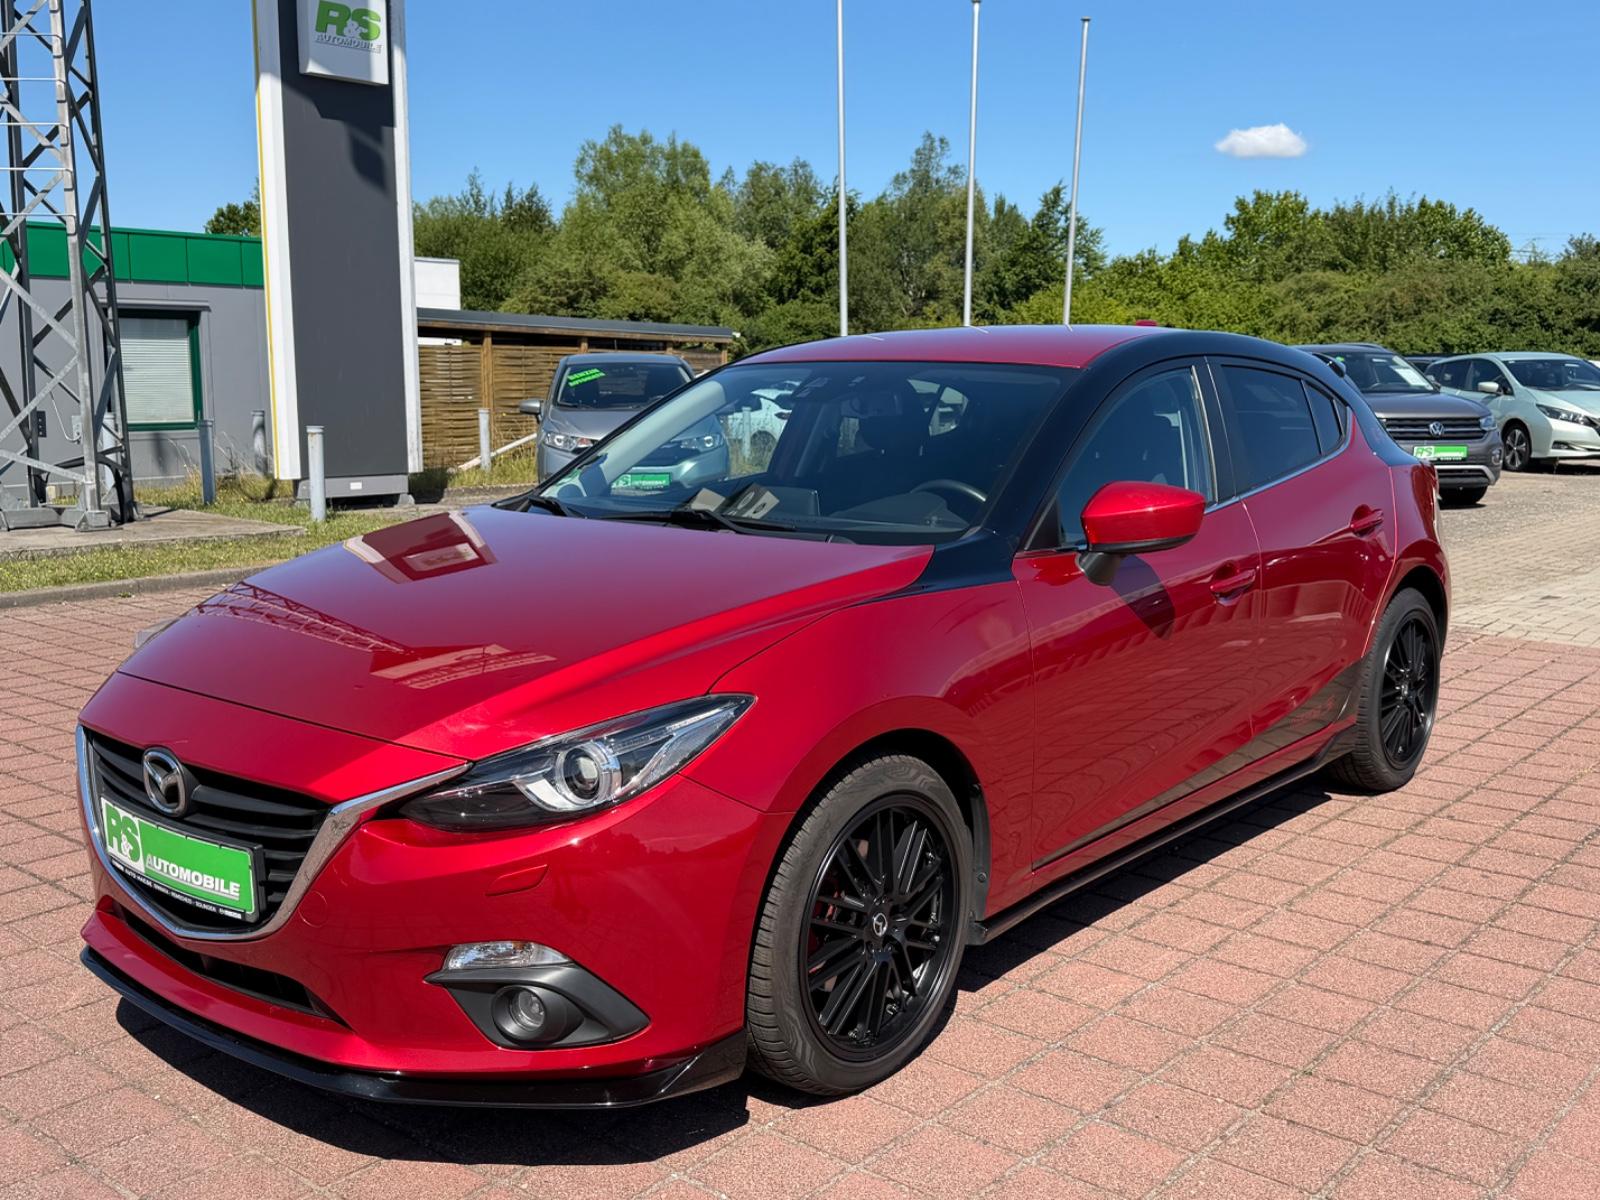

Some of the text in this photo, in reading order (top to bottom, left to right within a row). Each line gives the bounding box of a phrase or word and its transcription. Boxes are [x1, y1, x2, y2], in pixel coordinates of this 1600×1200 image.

[315, 1, 381, 41] R&S
[105, 802, 140, 862] R&S
[145, 853, 241, 897] AUTOMOBILE
